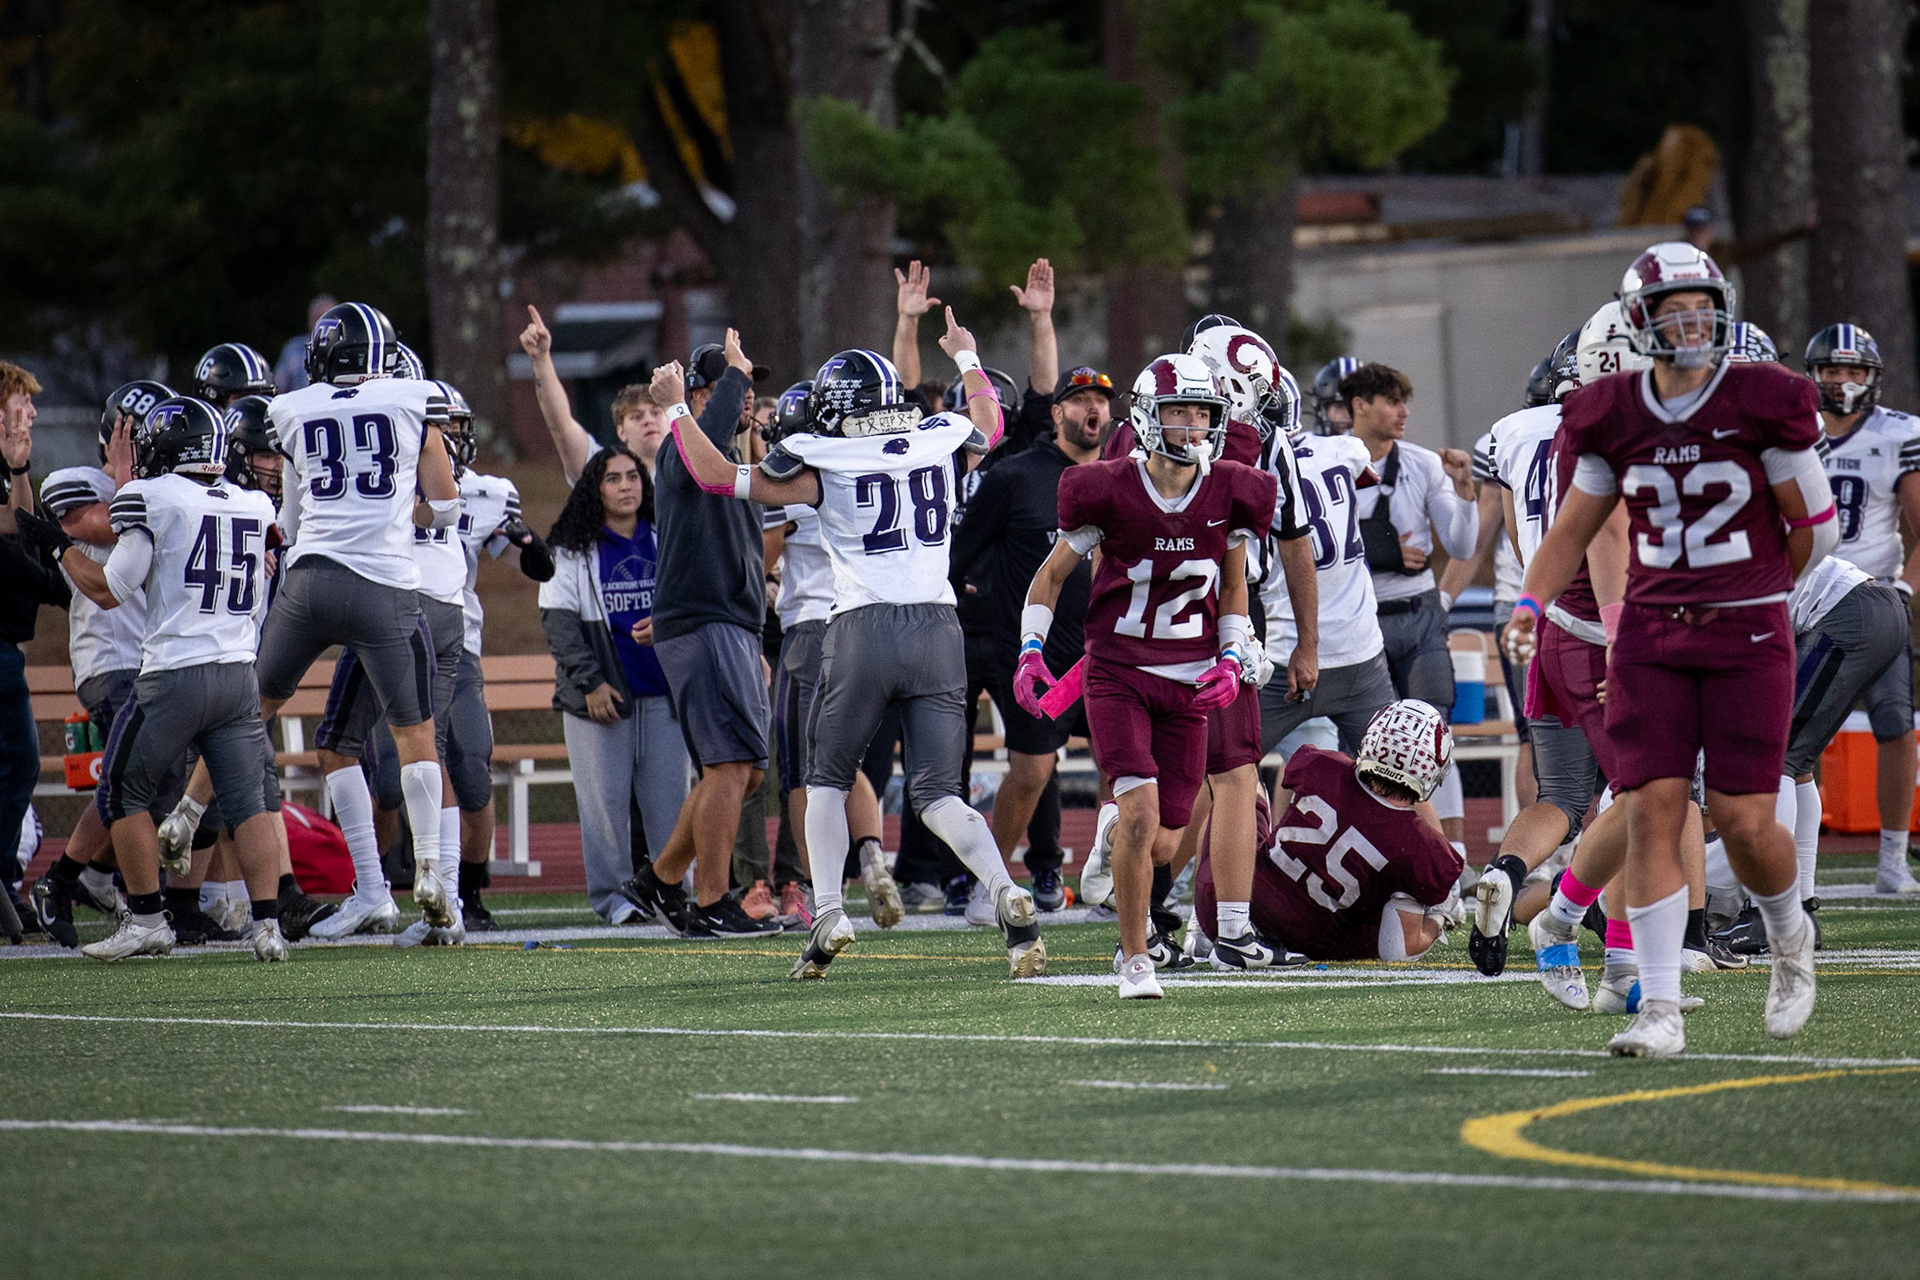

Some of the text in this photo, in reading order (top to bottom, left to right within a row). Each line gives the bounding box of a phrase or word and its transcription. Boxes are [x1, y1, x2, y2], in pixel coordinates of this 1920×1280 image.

[1599, 351, 1621, 373] 21
[122, 388, 156, 416] 68
[880, 414, 896, 429] RIP
[303, 413, 400, 500] 33
[1653, 444, 1701, 463] RAMS
[1837, 457, 1861, 470] TECH
[856, 464, 949, 555] 28
[1622, 460, 1752, 570] 32
[1154, 537, 1195, 551] RAMS
[184, 514, 261, 615] 45
[602, 581, 638, 591] LACKSTONE
[604, 590, 655, 614] SOFTB
[1113, 558, 1219, 640] 12
[1377, 746, 1408, 770] 25
[1374, 765, 1404, 781] schutt
[1269, 795, 1388, 911] 25
